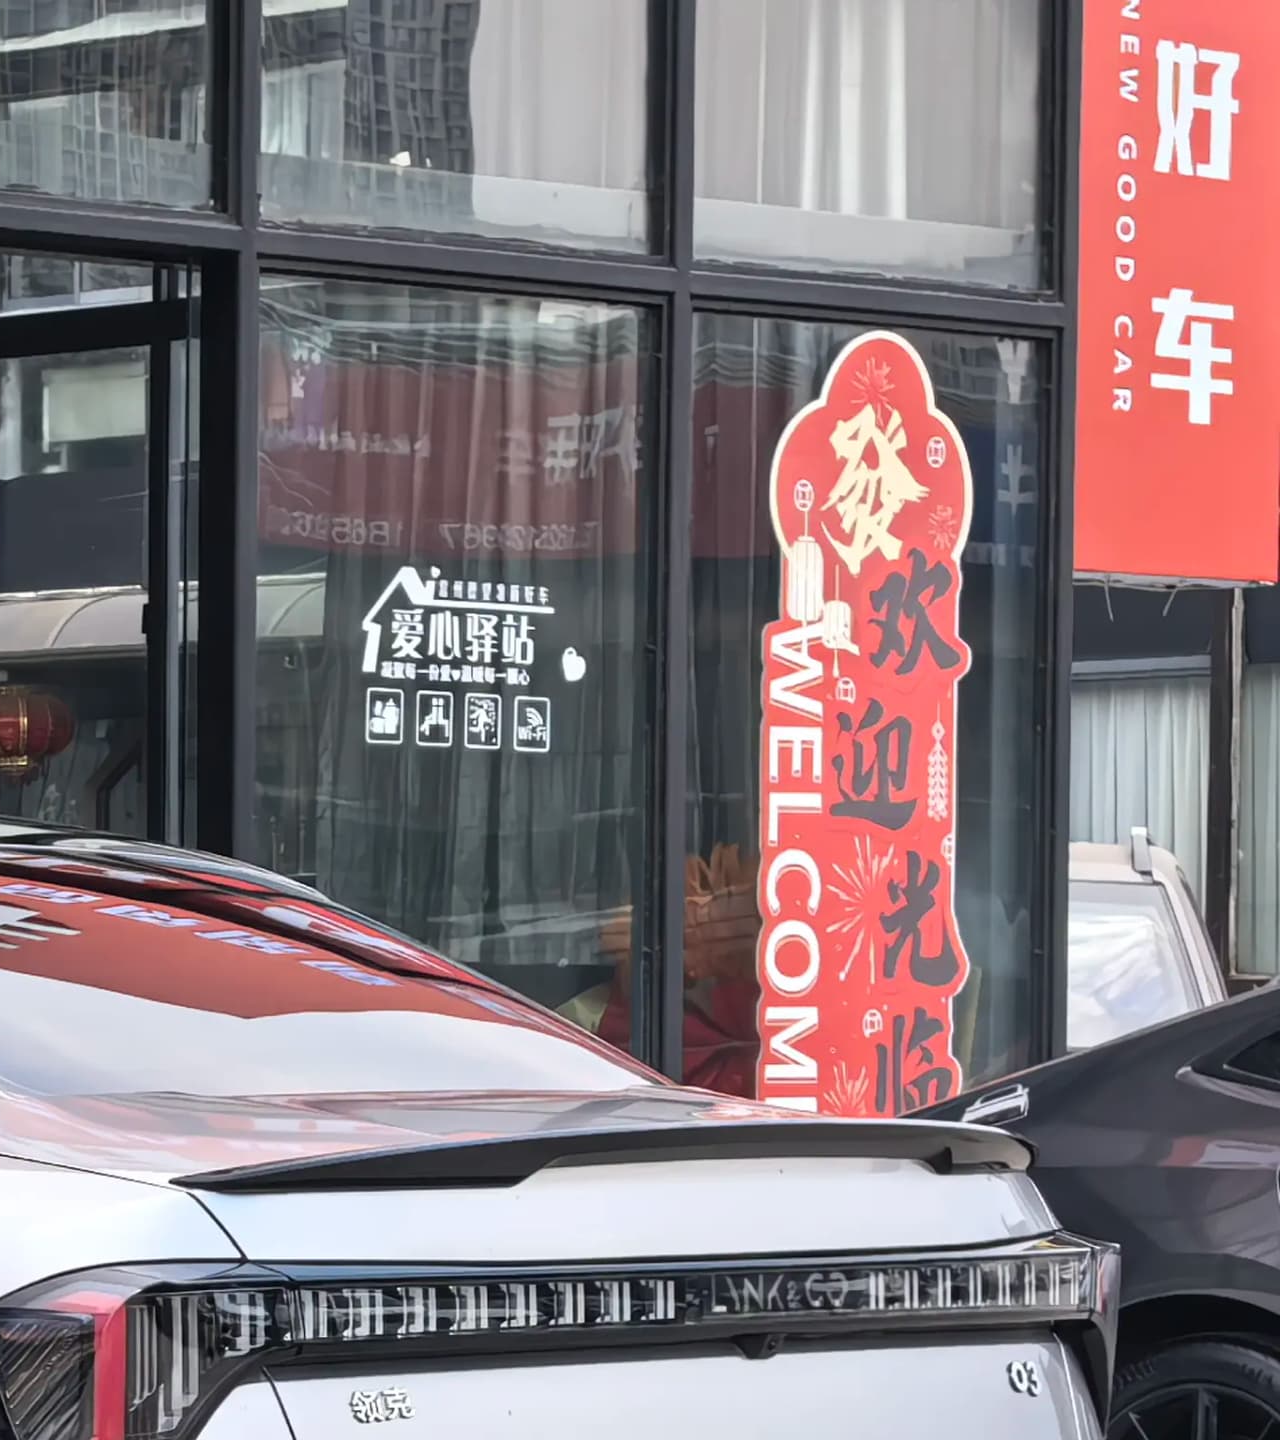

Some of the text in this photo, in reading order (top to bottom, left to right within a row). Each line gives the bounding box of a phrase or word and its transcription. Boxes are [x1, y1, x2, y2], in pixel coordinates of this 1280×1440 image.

[1112, 0, 1141, 413] NEW GOOD CAR
[1150, 38, 1241, 426] 好车
[391, 608, 536, 665] 爱心驿站
[764, 620, 824, 1118] WELCOM
[829, 546, 961, 1118] 欢迎光临
[348, 1386, 416, 1424] 领克
[1006, 1360, 1043, 1397] 03
